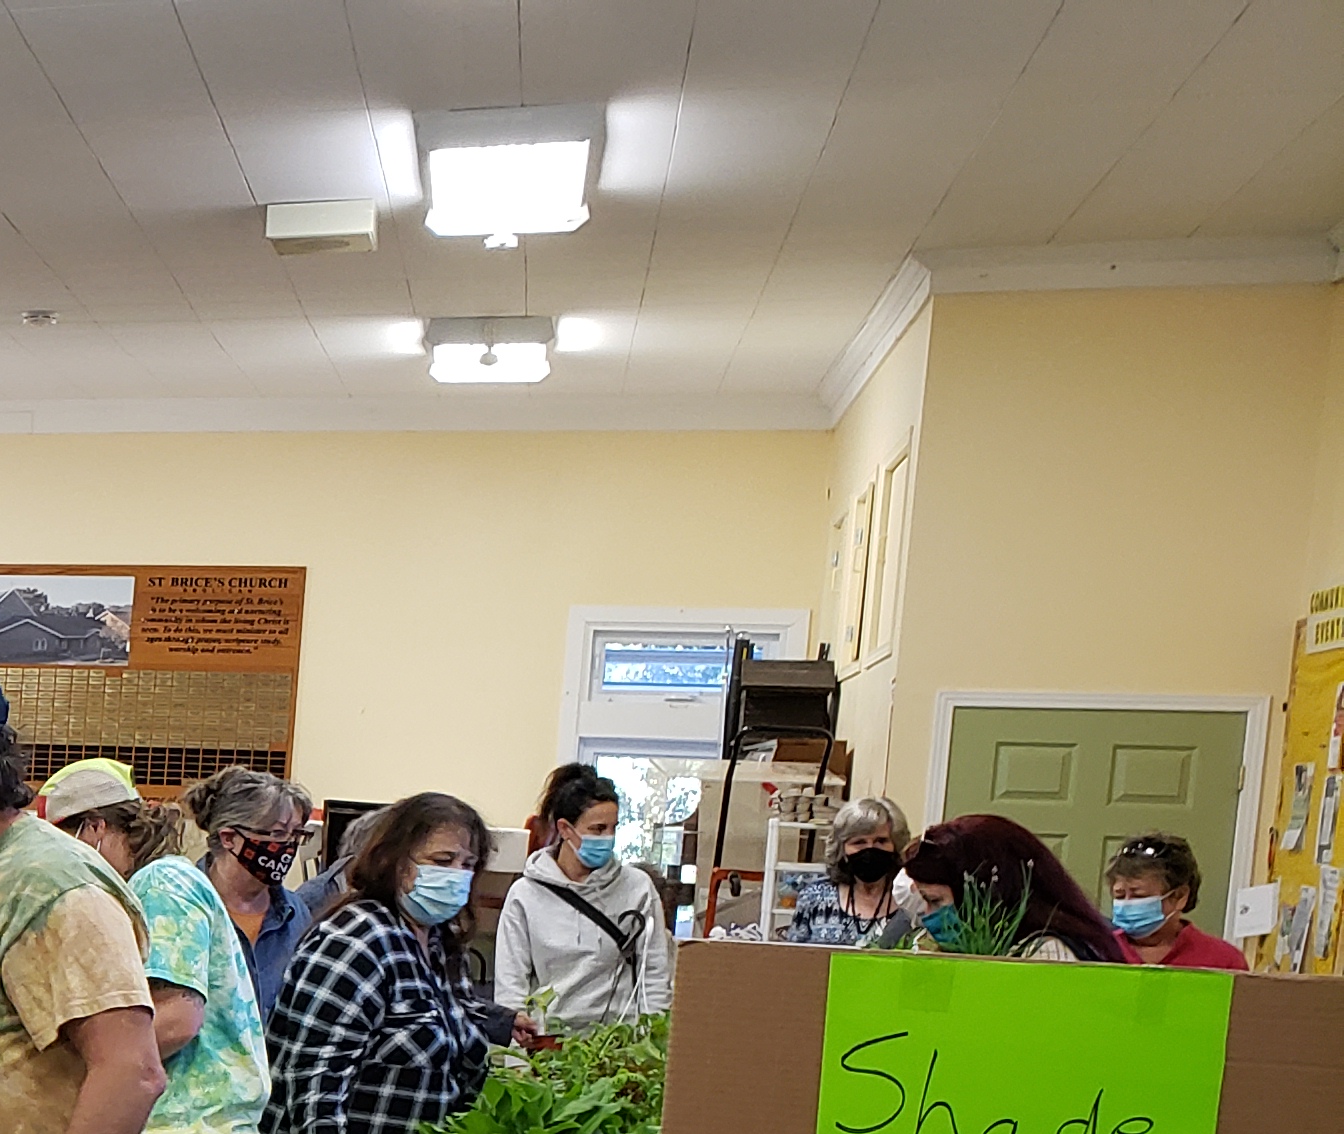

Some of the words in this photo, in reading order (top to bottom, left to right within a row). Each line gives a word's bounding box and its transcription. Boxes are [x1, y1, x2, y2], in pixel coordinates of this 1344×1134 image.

[148, 576, 165, 588] ST
[170, 577, 225, 588] BRICE'S
[227, 577, 288, 589] CHURCH
